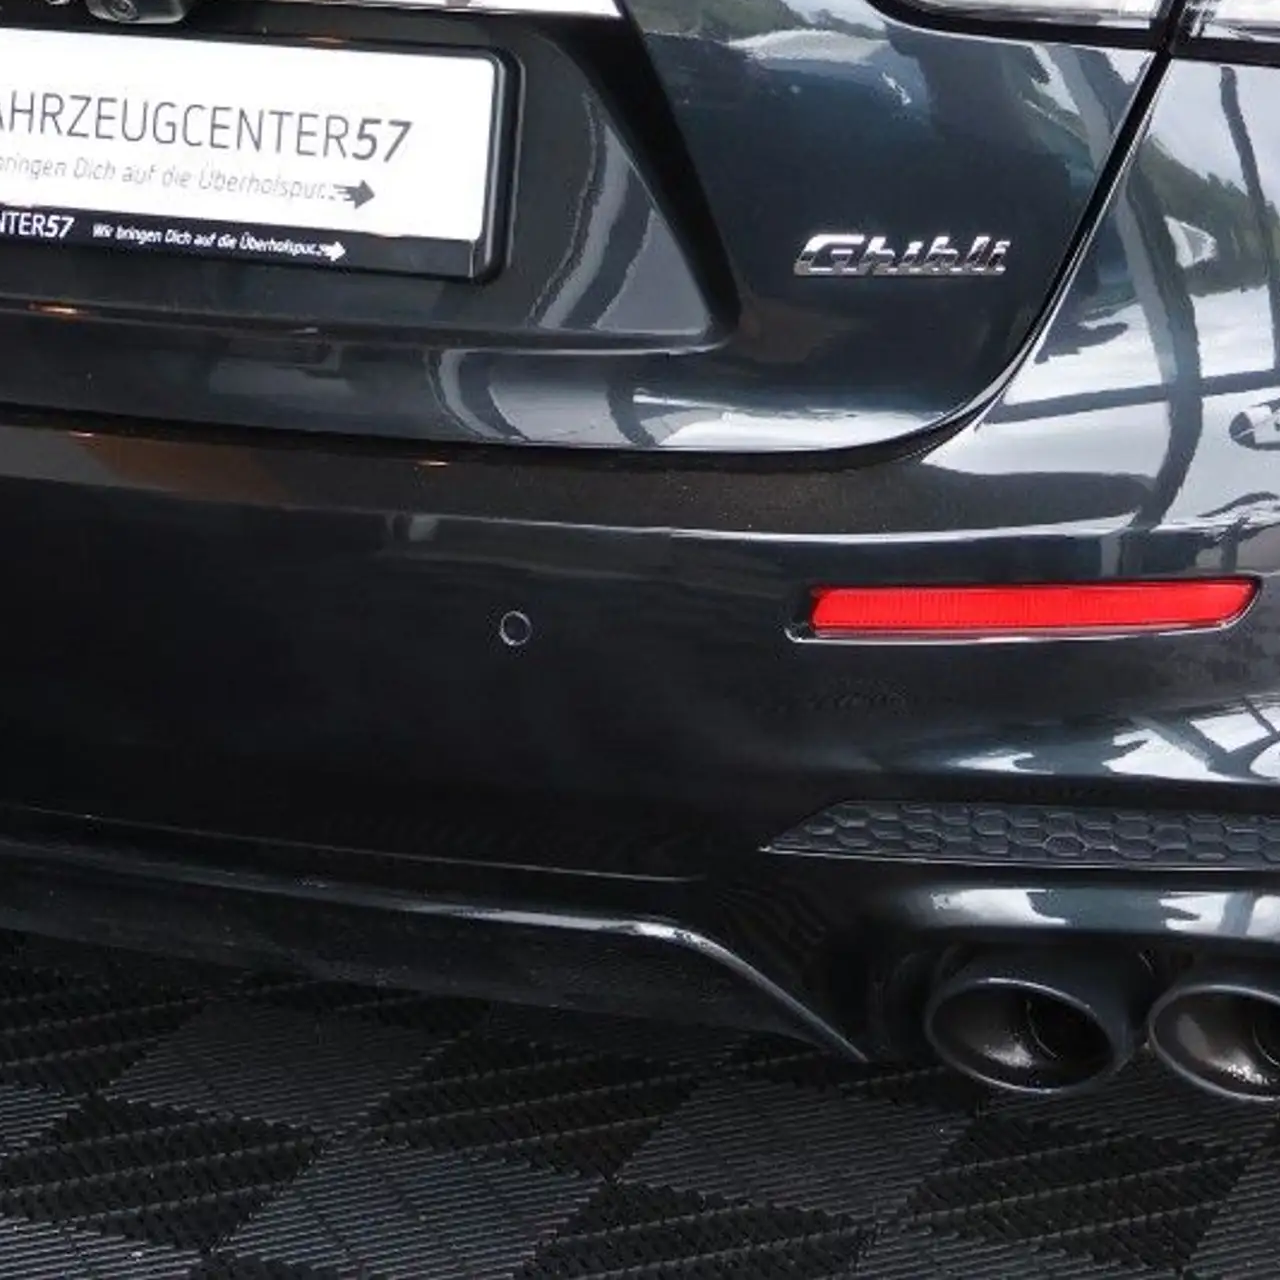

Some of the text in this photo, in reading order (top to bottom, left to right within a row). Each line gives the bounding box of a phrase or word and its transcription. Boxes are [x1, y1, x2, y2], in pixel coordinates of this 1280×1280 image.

[73, 154, 115, 180] Dich
[122, 162, 157, 185] auf
[161, 164, 190, 188] die
[92, 222, 113, 238] Wir
[115, 224, 162, 246] bringen
[164, 227, 191, 246] Dich
[194, 231, 216, 248] auf
[217, 232, 238, 249] die
[793, 233, 1011, 276] Ghibli
